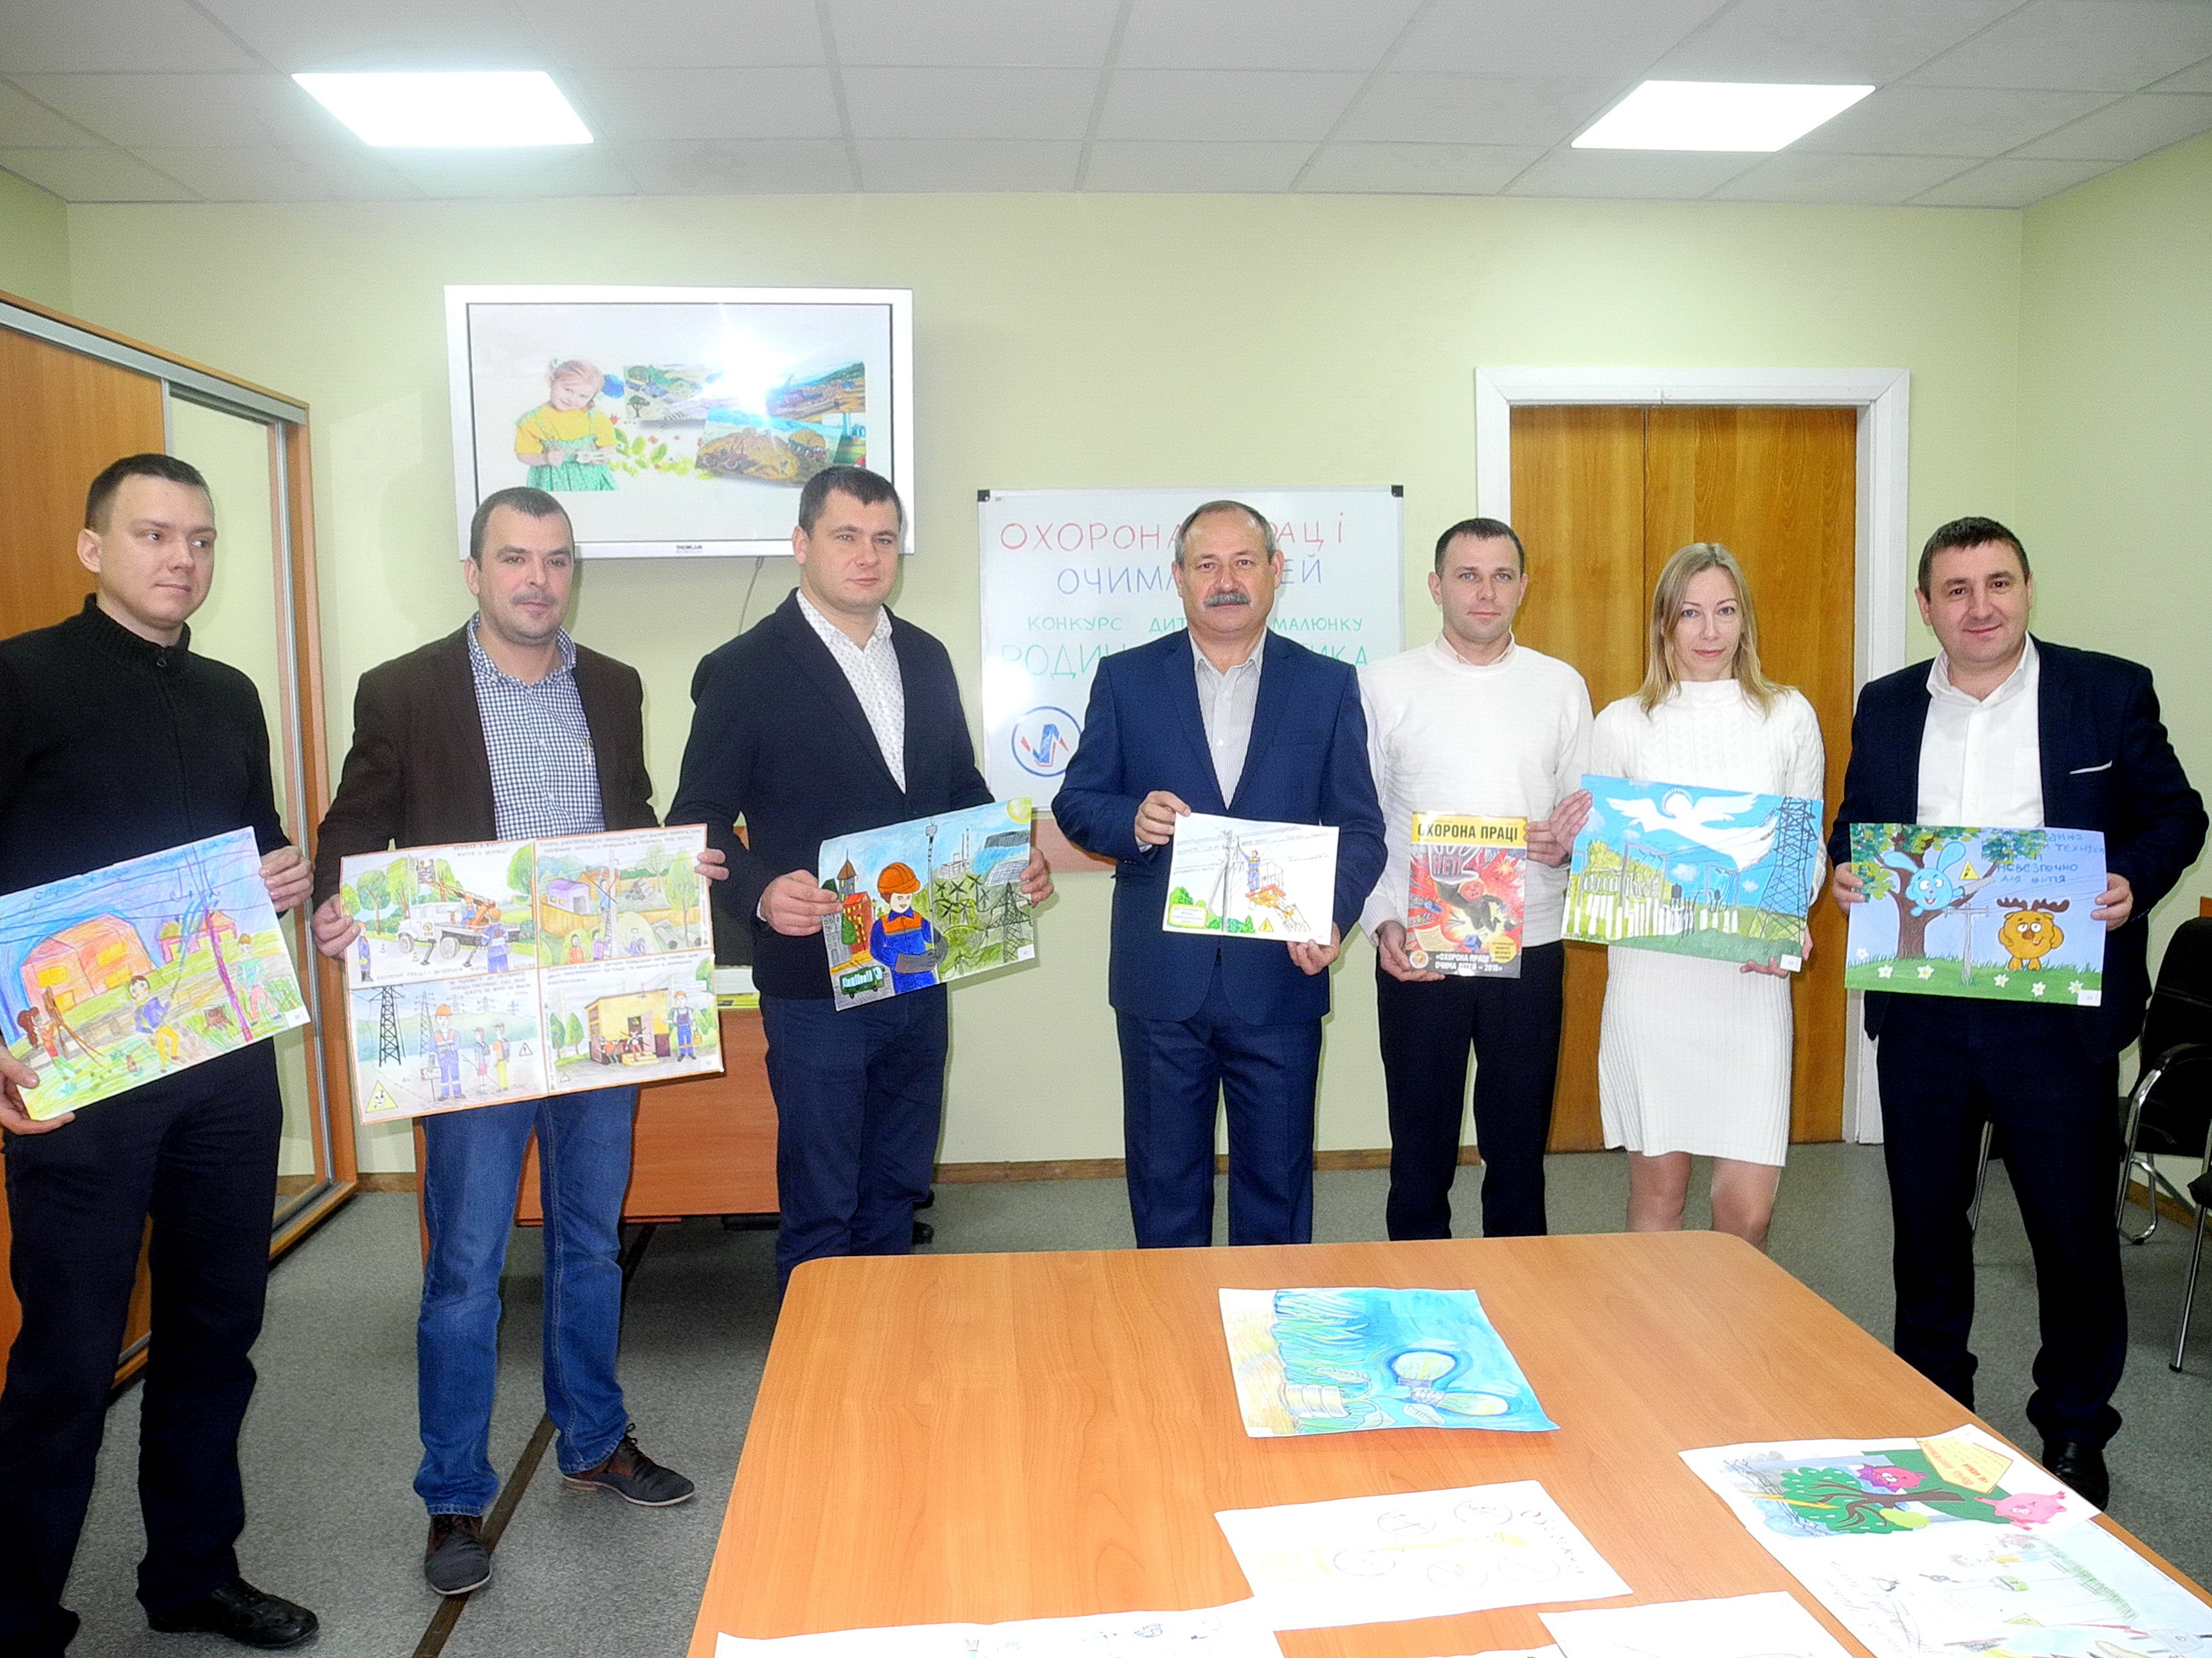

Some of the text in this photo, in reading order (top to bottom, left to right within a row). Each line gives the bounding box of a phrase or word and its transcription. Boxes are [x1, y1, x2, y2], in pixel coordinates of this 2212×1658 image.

[1028, 617, 1123, 632] КОНКУРС
[1273, 617, 1363, 632] МАЛЮНКУ
[1481, 826, 1518, 843] ПРАЦІ
